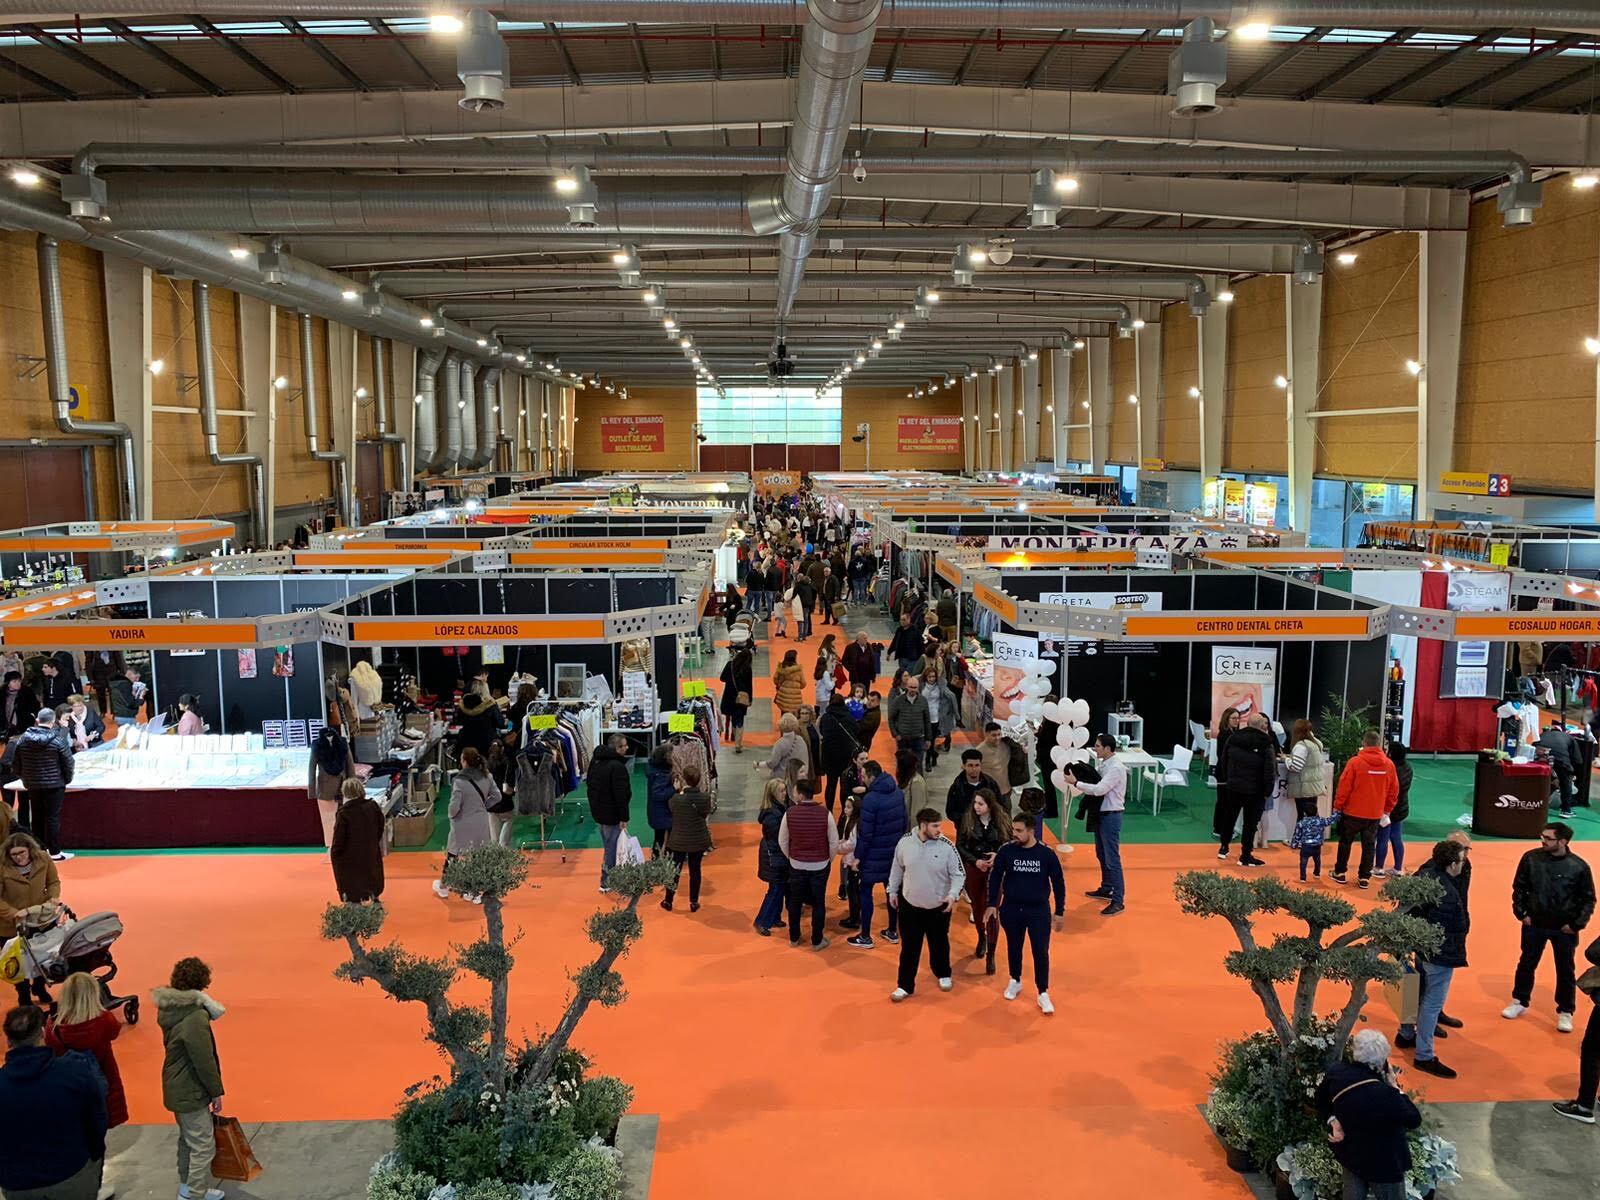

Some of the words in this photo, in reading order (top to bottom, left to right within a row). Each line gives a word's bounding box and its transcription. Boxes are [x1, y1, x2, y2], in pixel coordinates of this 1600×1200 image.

[635, 416, 664, 424] EMBARGO
[1489, 477, 1498, 492] 2
[1500, 478, 1509, 492] 3
[1054, 598, 1092, 606] CRETA
[1116, 595, 1143, 604] SORTEO
[434, 624, 465, 636] LÓPEZ
[468, 625, 518, 636] CALZADOS
[1197, 621, 1234, 631] CENTRO
[1236, 621, 1272, 631] DENTAL
[1274, 620, 1304, 630] CRETA
[1508, 621, 1557, 631] ECOSALUD
[109, 629, 145, 639] YADIRA
[998, 646, 1034, 658] CRETA
[1221, 660, 1272, 671] CRETA
[1509, 800, 1540, 808] STEAM
